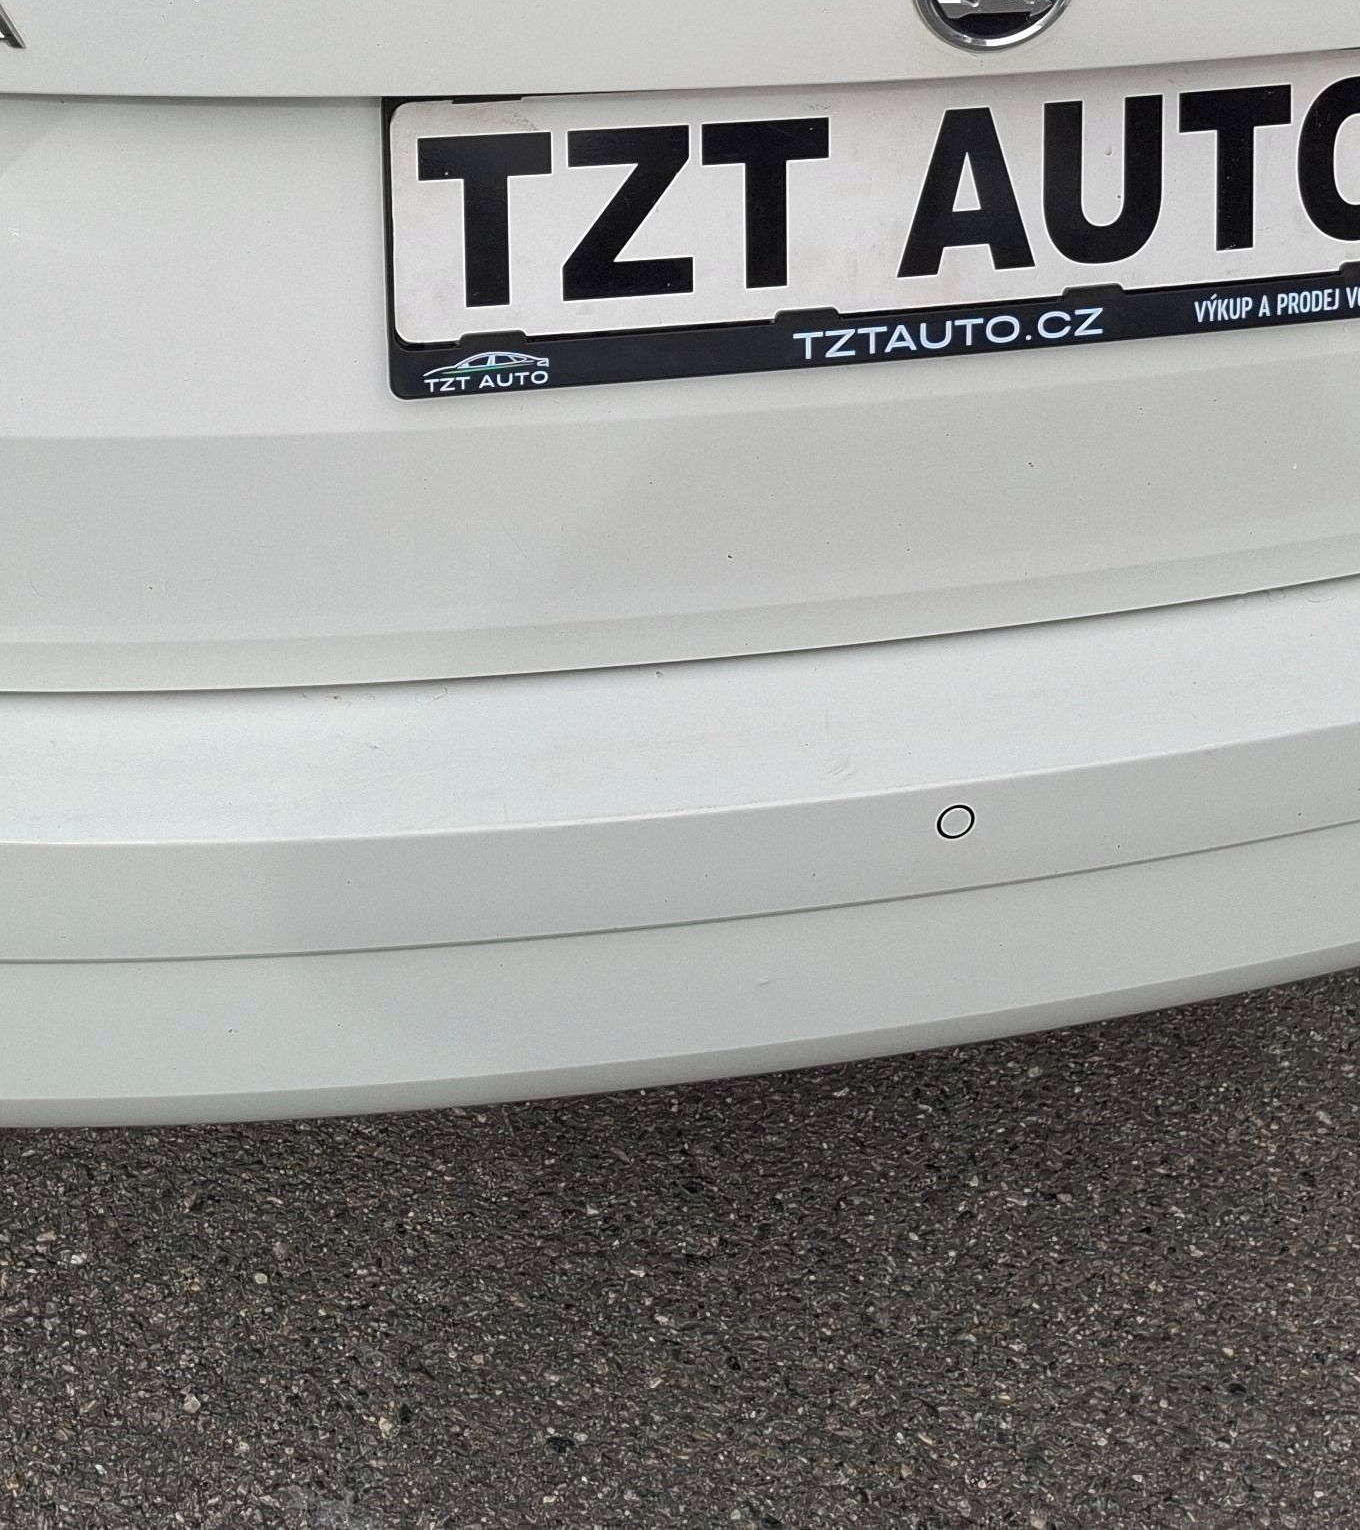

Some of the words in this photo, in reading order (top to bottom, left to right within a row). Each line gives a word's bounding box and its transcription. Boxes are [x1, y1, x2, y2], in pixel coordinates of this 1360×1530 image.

[417, 117, 830, 307] TZT
[1194, 293, 1253, 322] VÝKUP
[1258, 295, 1271, 317] A
[1277, 288, 1340, 316] PRODEJ
[793, 308, 1103, 359] TZTAUTO.CZ
[424, 376, 470, 392] TZT
[479, 371, 549, 388] AUTO
